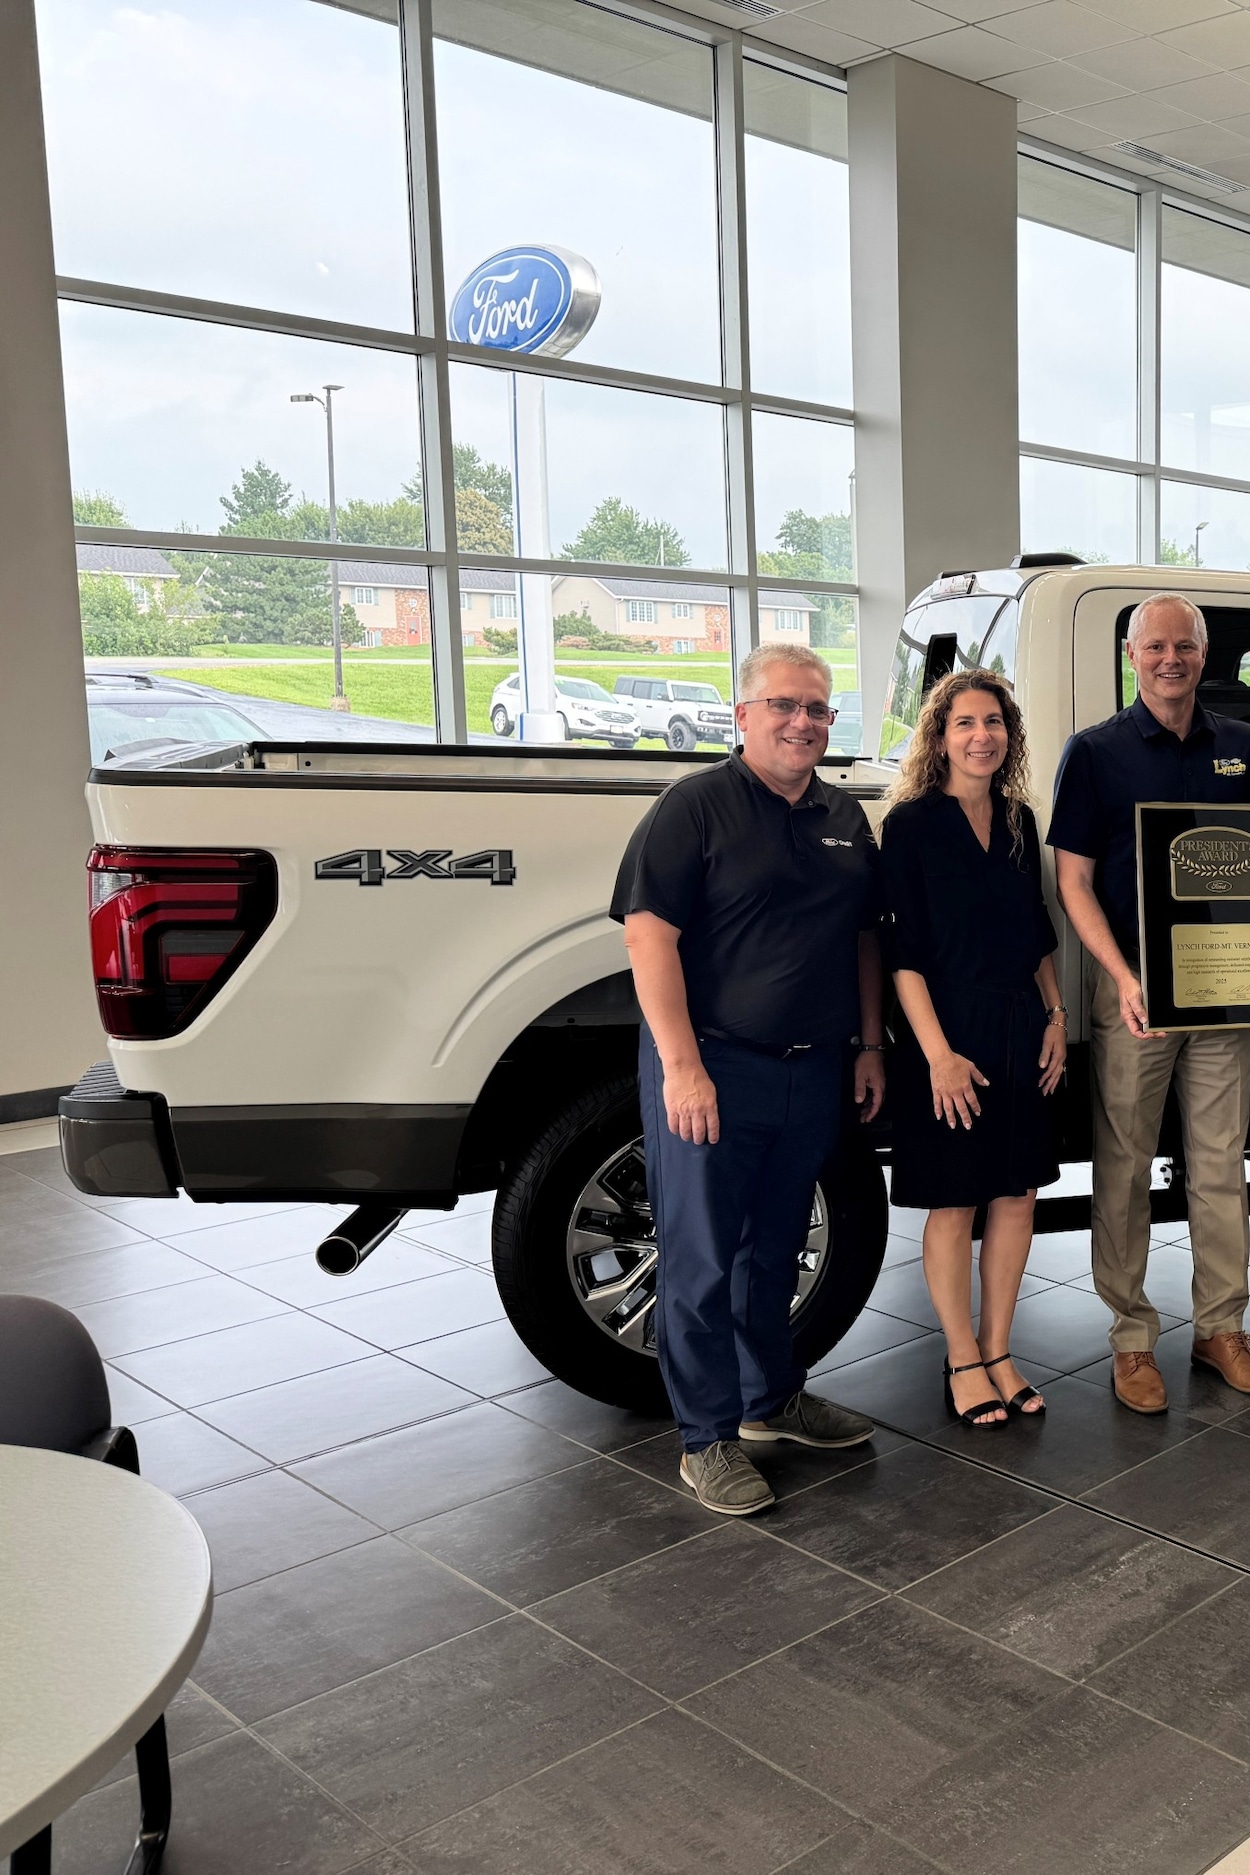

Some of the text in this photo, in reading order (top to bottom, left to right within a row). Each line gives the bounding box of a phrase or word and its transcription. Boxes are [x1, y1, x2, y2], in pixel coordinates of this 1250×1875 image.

[469, 269, 538, 345] Ford
[1198, 851, 1239, 861] AWARD
[1210, 881, 1227, 890] Ford
